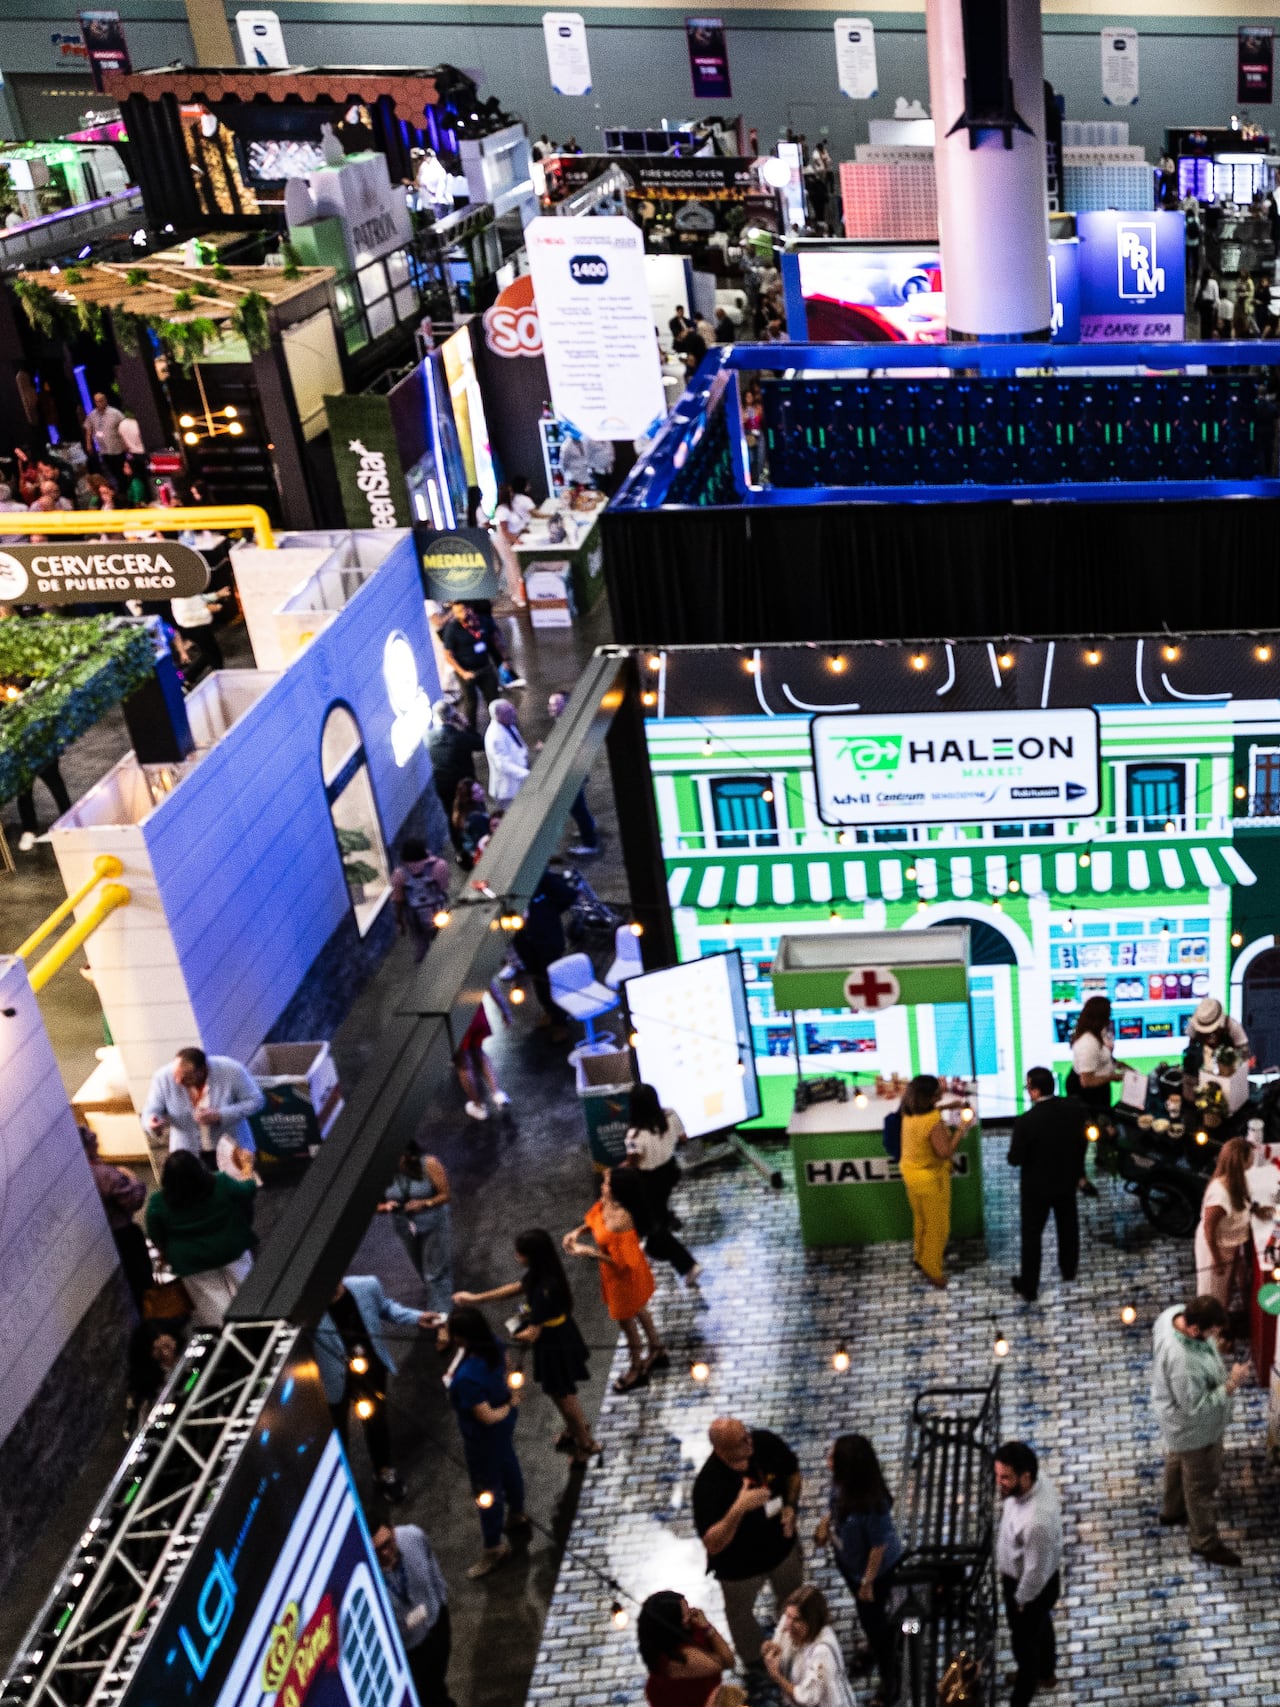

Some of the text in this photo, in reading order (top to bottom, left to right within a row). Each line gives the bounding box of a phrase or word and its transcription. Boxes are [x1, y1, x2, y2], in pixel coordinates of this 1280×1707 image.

[572, 262, 607, 277] 1400
[1104, 323, 1139, 337] CARE
[1143, 322, 1171, 336] ERA
[31, 553, 174, 578] CERVECERA
[422, 552, 488, 569] MEDALLA
[37, 575, 176, 592] DE PUERTO RICO
[909, 736, 1073, 763] HALEON
[961, 766, 1023, 778] MARKET
[806, 1154, 968, 1183] HALEN
